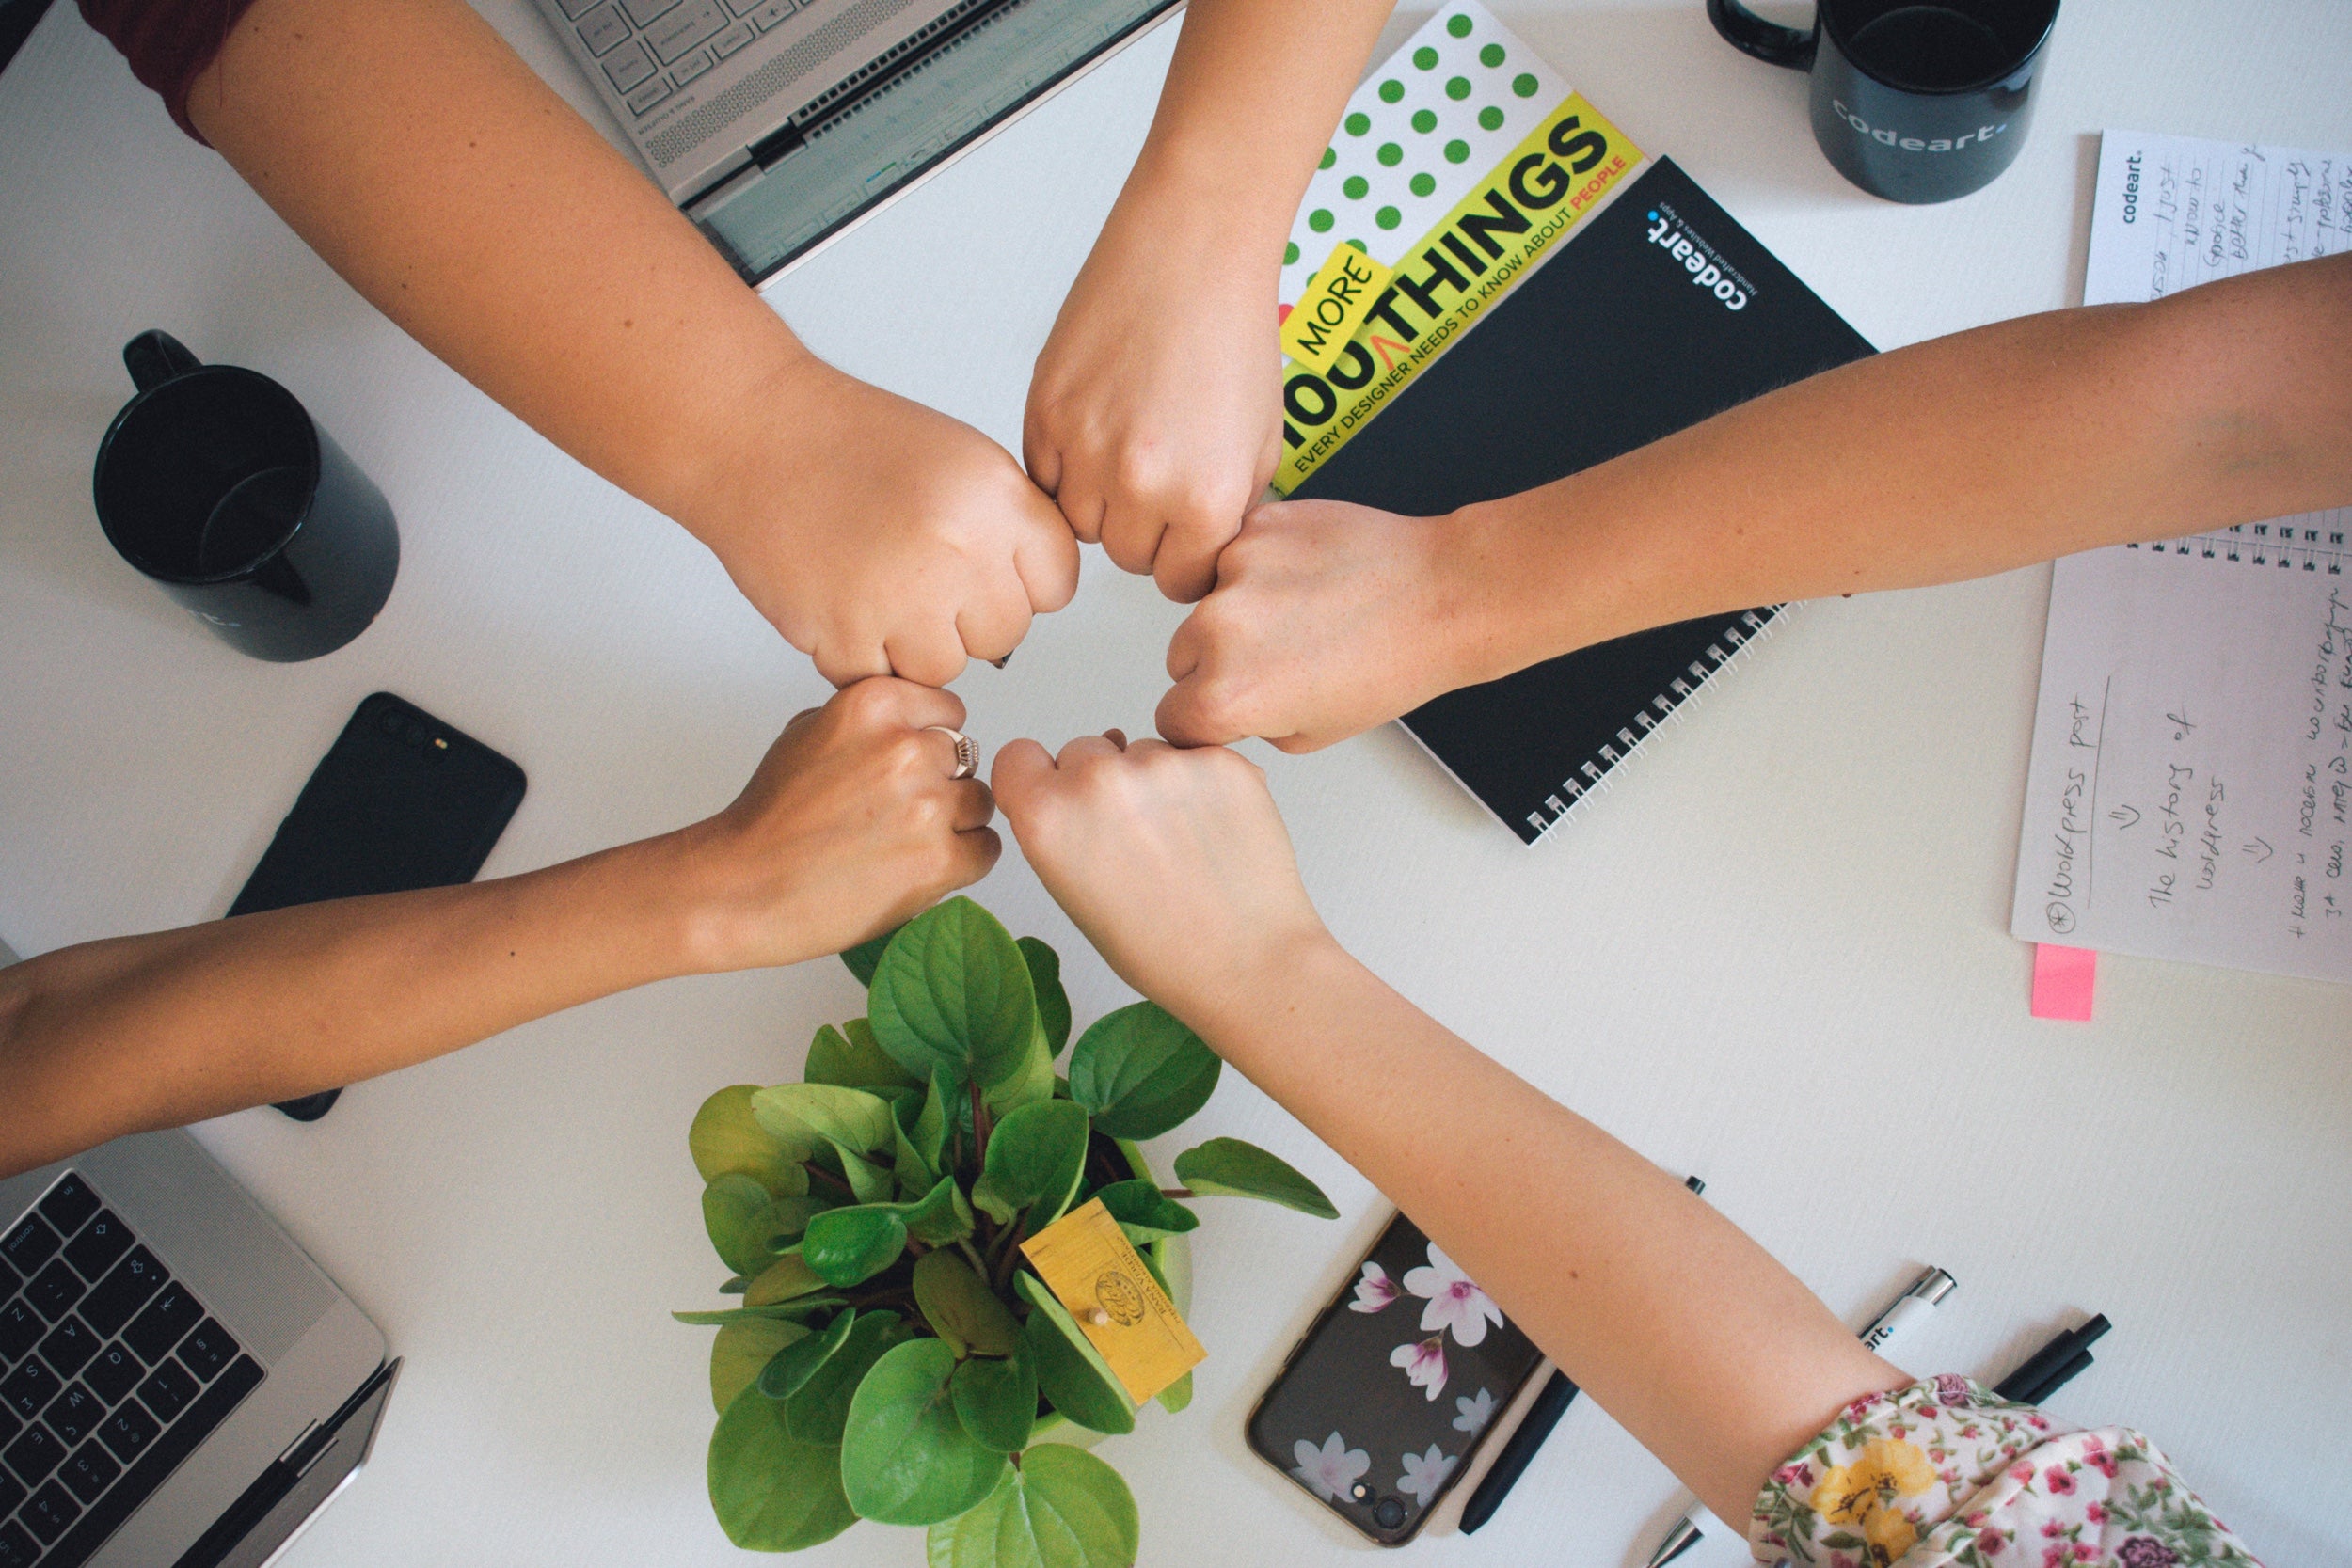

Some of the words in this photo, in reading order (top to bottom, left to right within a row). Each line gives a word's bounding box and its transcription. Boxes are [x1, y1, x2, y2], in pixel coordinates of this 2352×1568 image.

[1659, 201, 1677, 221] Apps
[1676, 217, 1684, 229] &
[1363, 115, 1608, 344] THINGS
[1683, 225, 1715, 258] Websites
[1712, 253, 1758, 297] Handcrafted
[1294, 426, 1342, 473] EVERY
[1341, 362, 1411, 430] DESIGNER
[1409, 317, 1458, 365] NEEDS
[1455, 298, 1479, 320] TO
[1477, 254, 1523, 300] KNOW
[1523, 206, 1572, 258] ABOUT
[1569, 155, 1626, 211] PEOPLE
[1296, 255, 1372, 356] MORE
[2070, 692, 2098, 748] post
[2166, 705, 2197, 741] of
[2155, 763, 2193, 859] history
[2149, 872, 2175, 908] The
[8, 1224, 35, 1252] control
[12, 1307, 24, 1322] Z
[65, 1324, 76, 1337] A
[26, 1365, 38, 1377] S
[108, 1351, 121, 1363] Q
[69, 1392, 84, 1407] W
[31, 1431, 43, 1445] E
[117, 1418, 129, 1431] 2
